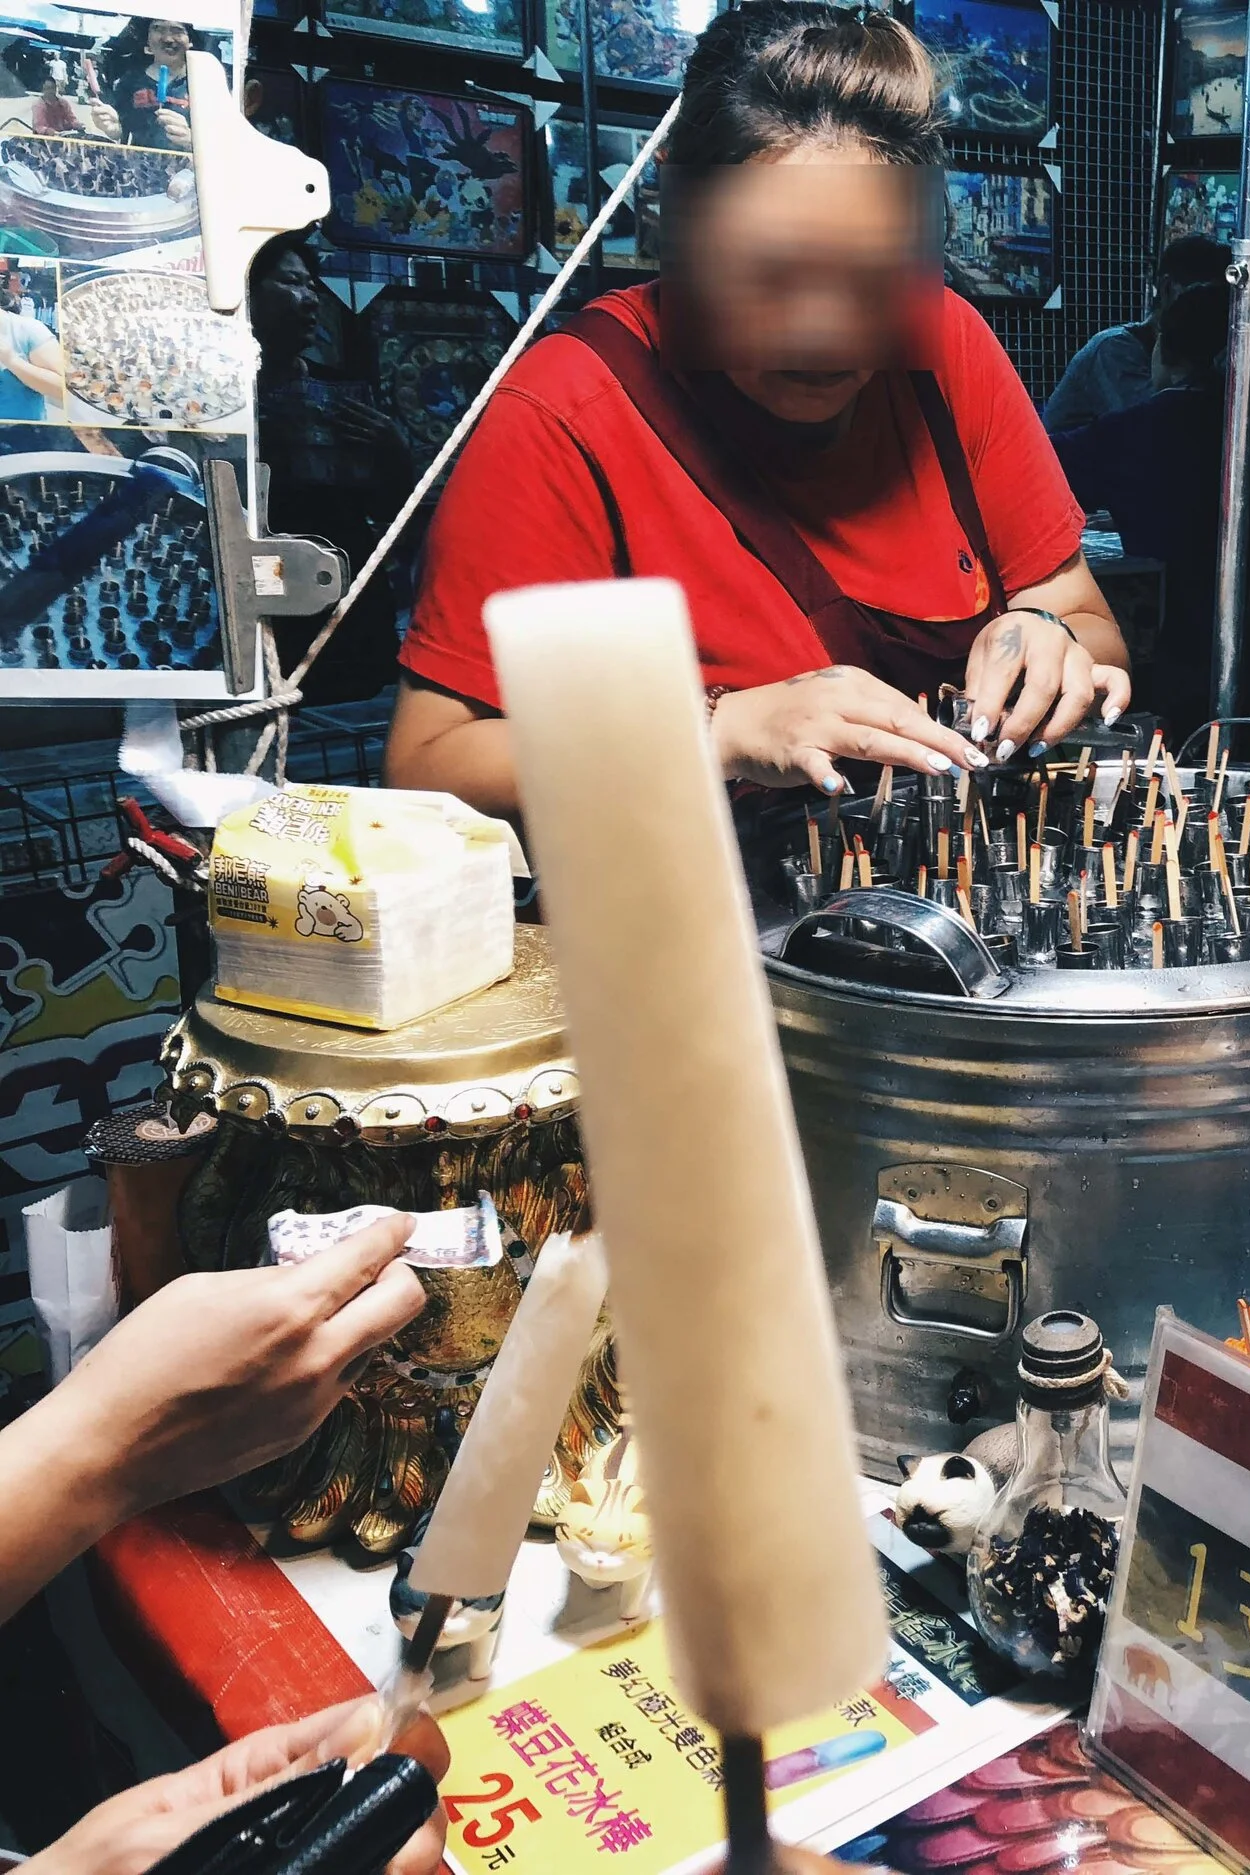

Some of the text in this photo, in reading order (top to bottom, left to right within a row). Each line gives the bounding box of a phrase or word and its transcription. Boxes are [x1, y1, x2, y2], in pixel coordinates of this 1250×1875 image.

[214, 854, 271, 888] 邦尼熊
[215, 882, 269, 903] BENI BEAR
[487, 1699, 653, 1855] 蝶豆花冰棒
